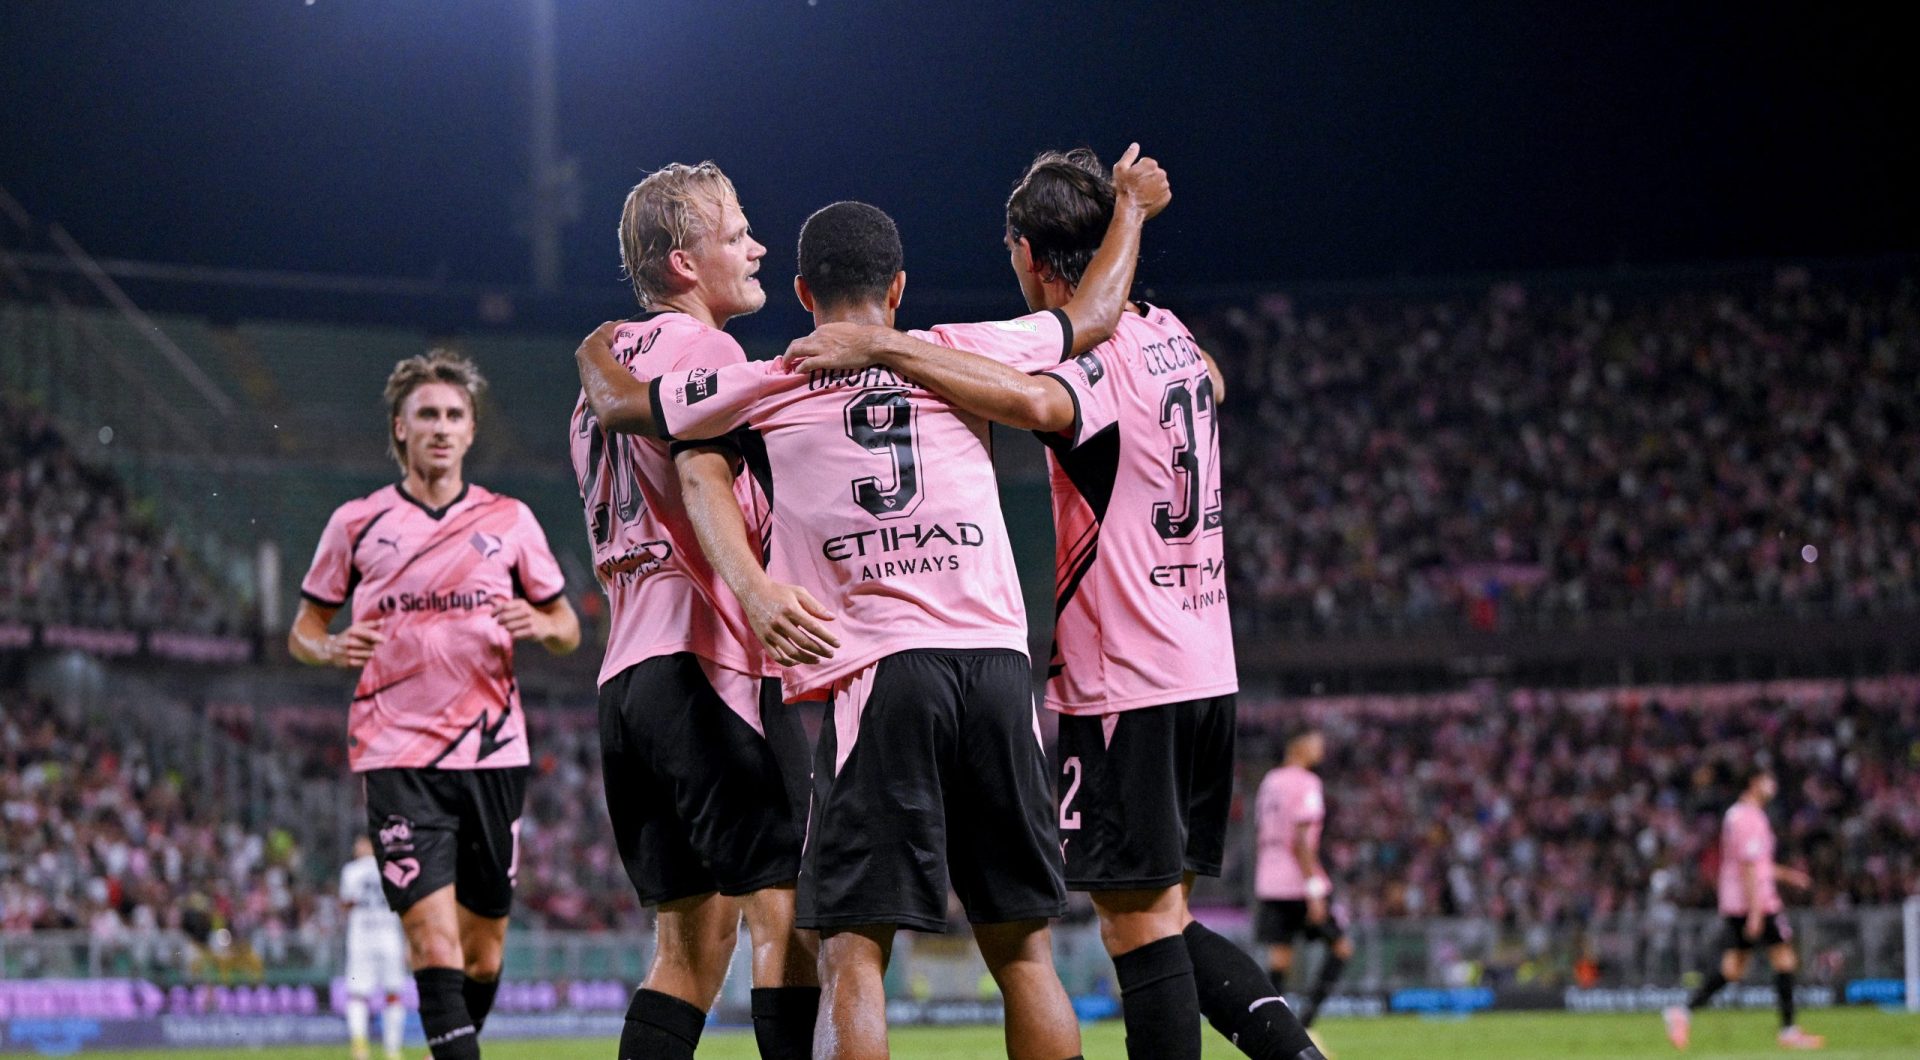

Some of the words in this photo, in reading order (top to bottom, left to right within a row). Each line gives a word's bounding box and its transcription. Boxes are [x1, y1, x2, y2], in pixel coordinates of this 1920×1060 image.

[843, 387, 925, 521] 9
[1151, 369, 1222, 545] 32
[823, 522, 984, 562] ETIHAD
[861, 555, 960, 582] AIRWAYS
[400, 591, 448, 612] Sicily
